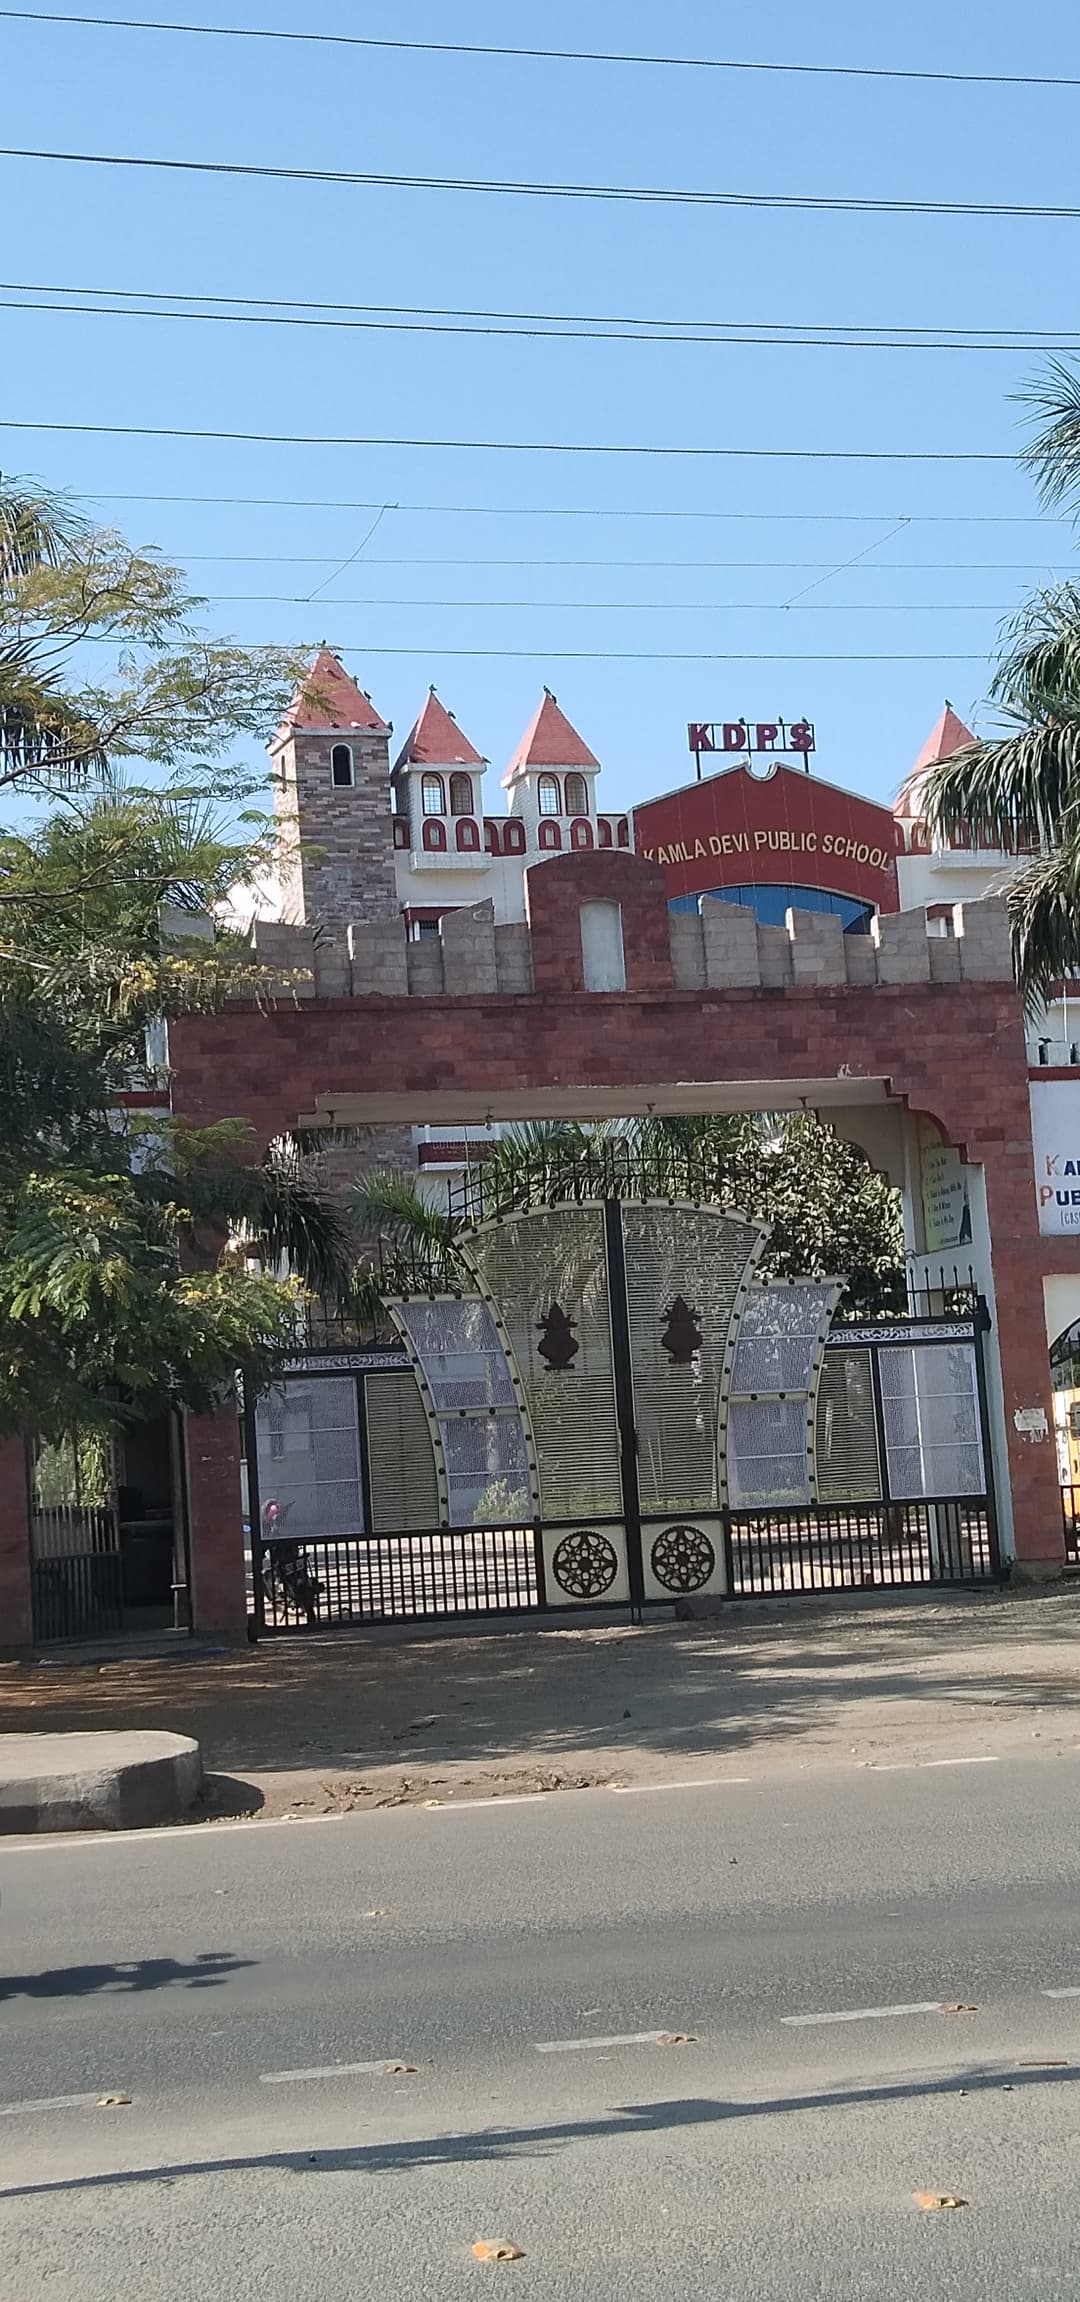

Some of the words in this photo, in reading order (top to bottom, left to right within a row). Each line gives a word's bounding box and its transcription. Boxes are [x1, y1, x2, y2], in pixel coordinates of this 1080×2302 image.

[688, 723, 814, 751] KDPS
[643, 838, 707, 865] KAMLA
[709, 832, 749, 856] DEVI
[754, 831, 817, 852] PUBLIC
[822, 834, 888, 871] SCHOOL
